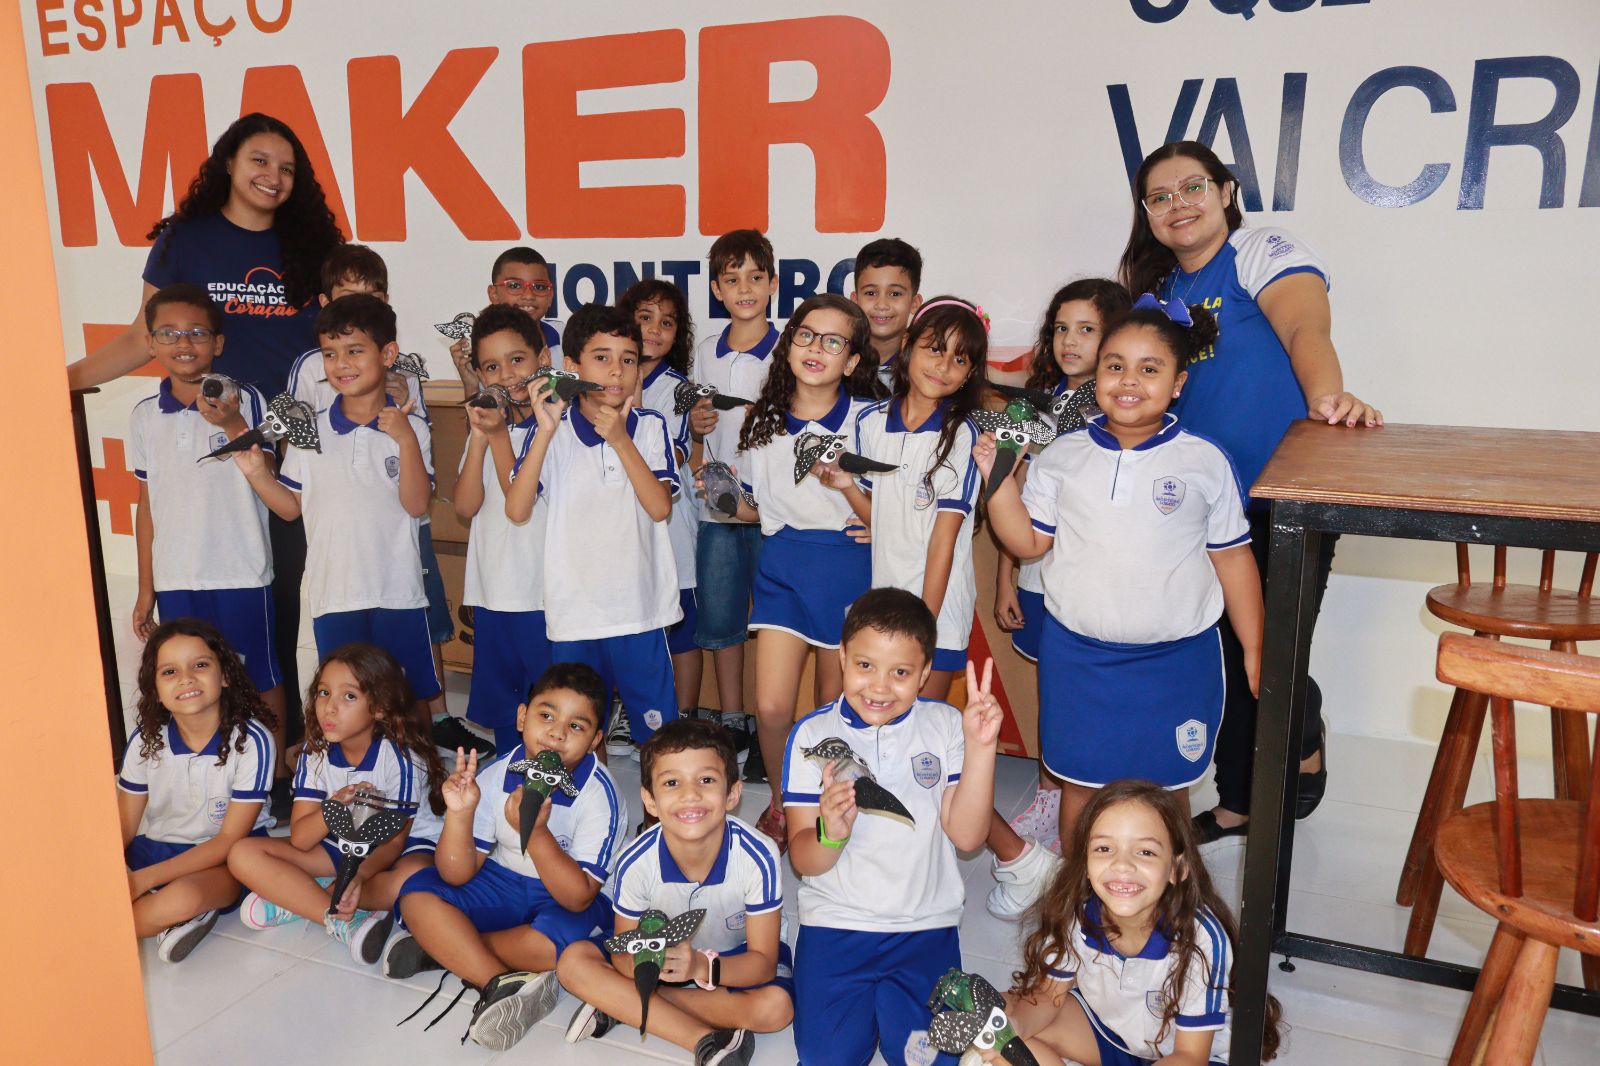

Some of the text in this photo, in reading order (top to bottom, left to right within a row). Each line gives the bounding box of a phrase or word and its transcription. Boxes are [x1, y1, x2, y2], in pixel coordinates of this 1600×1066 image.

[36, 0, 292, 56] ESPAÇO
[45, 15, 891, 247] MAKER
[1107, 56, 1600, 212] VAI CR
[207, 282, 285, 295] EDUCAÇÃO
[224, 298, 299, 318] Coração
[236, 295, 266, 304] VEM
[545, 258, 857, 318] ONTR
